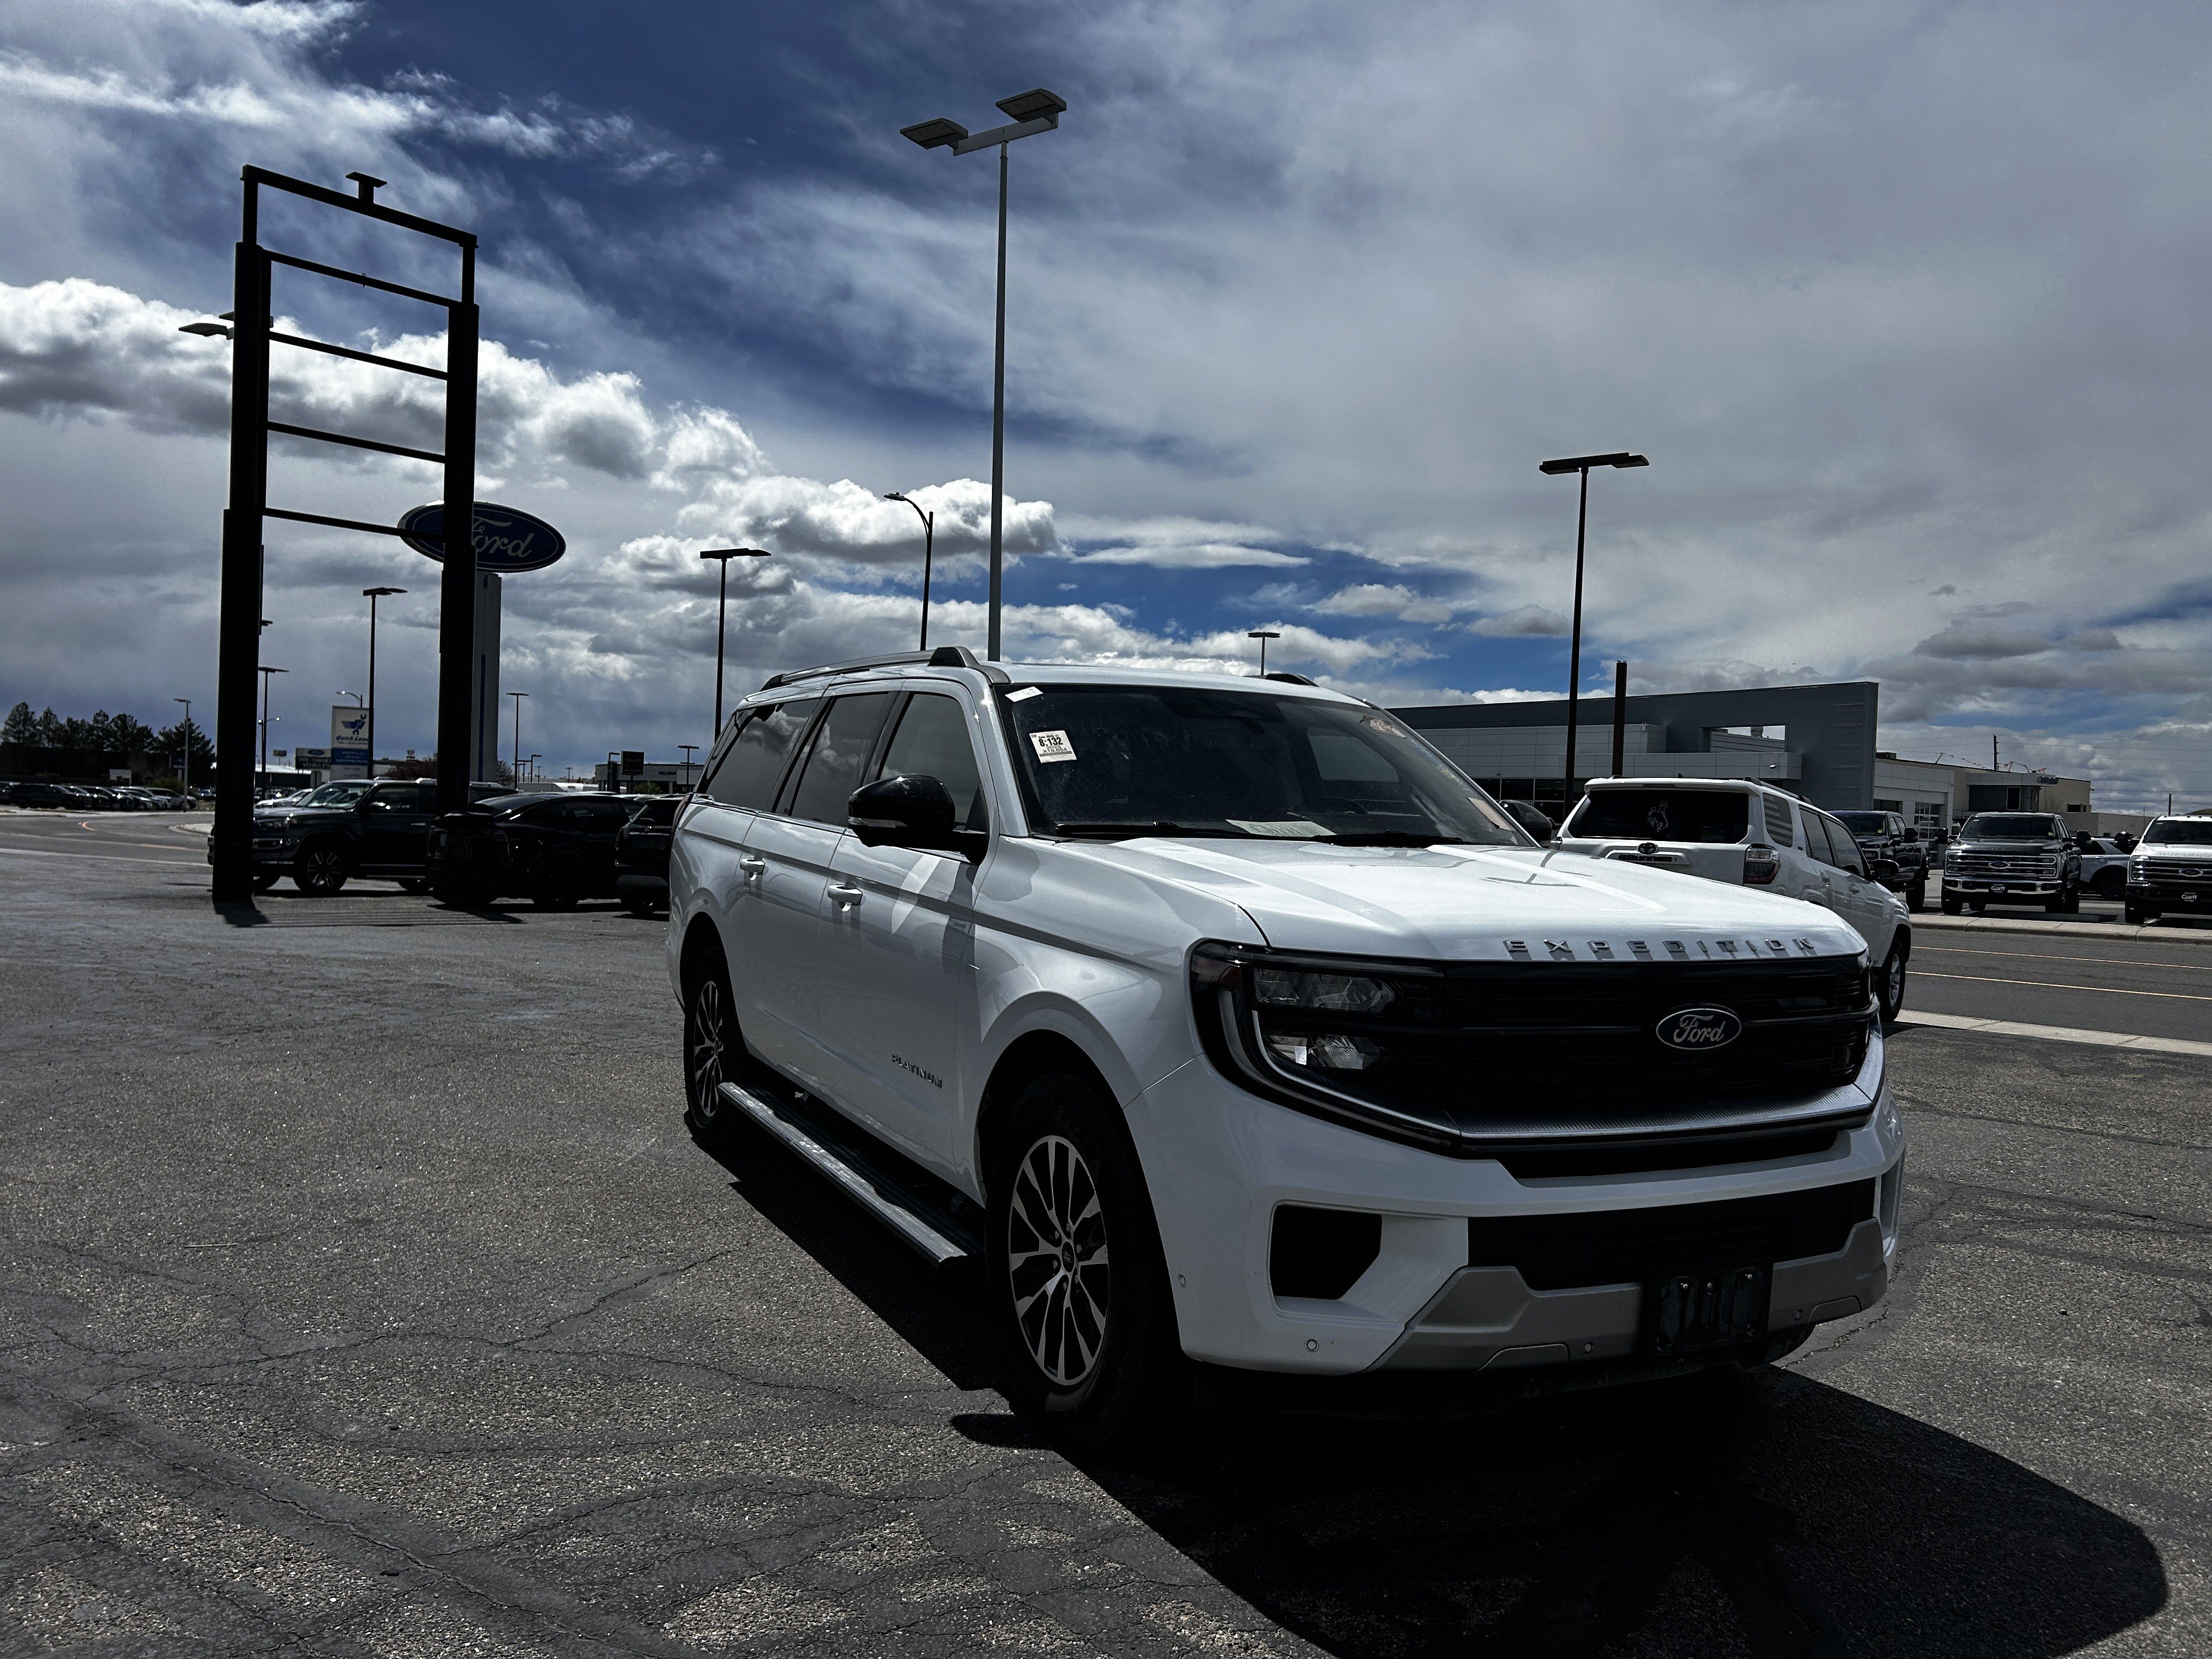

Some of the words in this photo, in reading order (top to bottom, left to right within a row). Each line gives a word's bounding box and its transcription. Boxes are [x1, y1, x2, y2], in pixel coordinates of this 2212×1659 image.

[1503, 937, 1816, 954] EXPEDITION
[1673, 1014, 1726, 1043] Ford
[891, 1053, 943, 1089] PLATINUM
